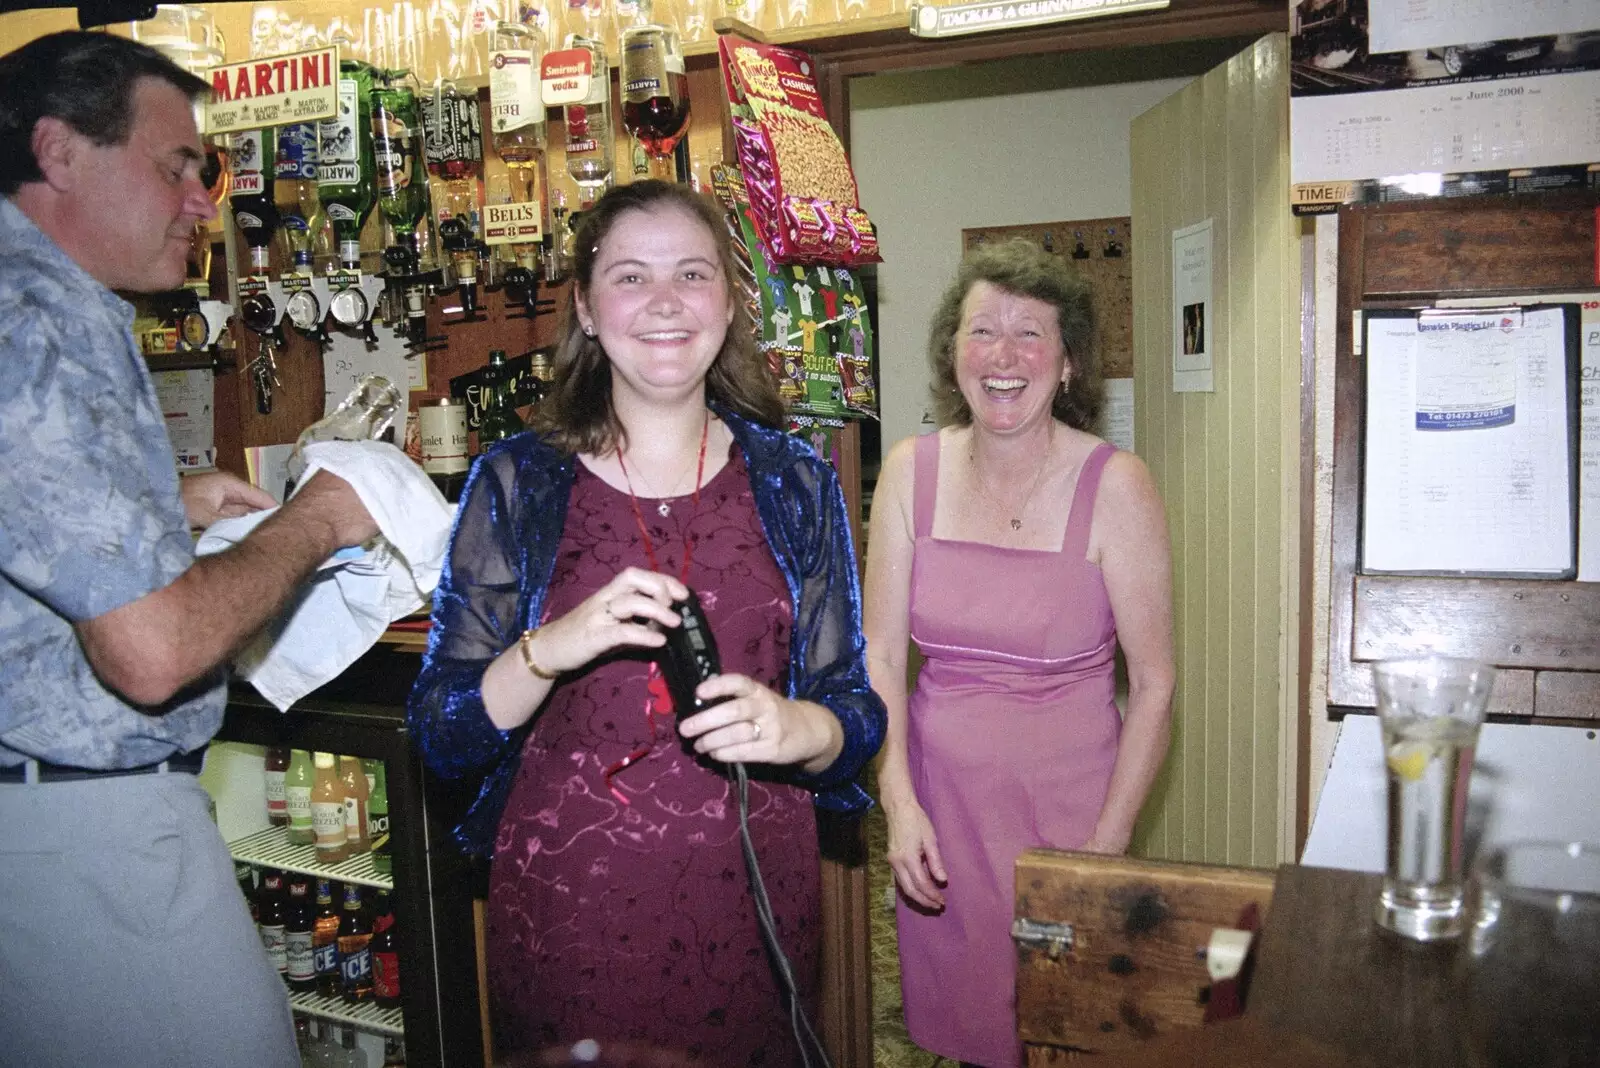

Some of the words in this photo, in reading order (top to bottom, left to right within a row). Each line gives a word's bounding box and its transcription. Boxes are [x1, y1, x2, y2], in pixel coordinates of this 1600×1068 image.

[941, 8, 1003, 27] TACKLE
[1005, 6, 1018, 19] A
[546, 60, 585, 76] Smirnoff
[211, 53, 332, 104] MARTINI
[552, 80, 578, 91] vodka
[781, 77, 816, 93] CASHEWS
[1467, 91, 1494, 100] June
[1497, 86, 1524, 97] 2000
[489, 205, 533, 223] BELL'S
[1298, 205, 1335, 213] TRANSPORT
[507, 226, 516, 237] 8
[283, 278, 309, 287] MARTINI
[329, 276, 358, 284] MARTINI
[1445, 412, 1471, 420] 01473
[341, 948, 372, 981] ICE
